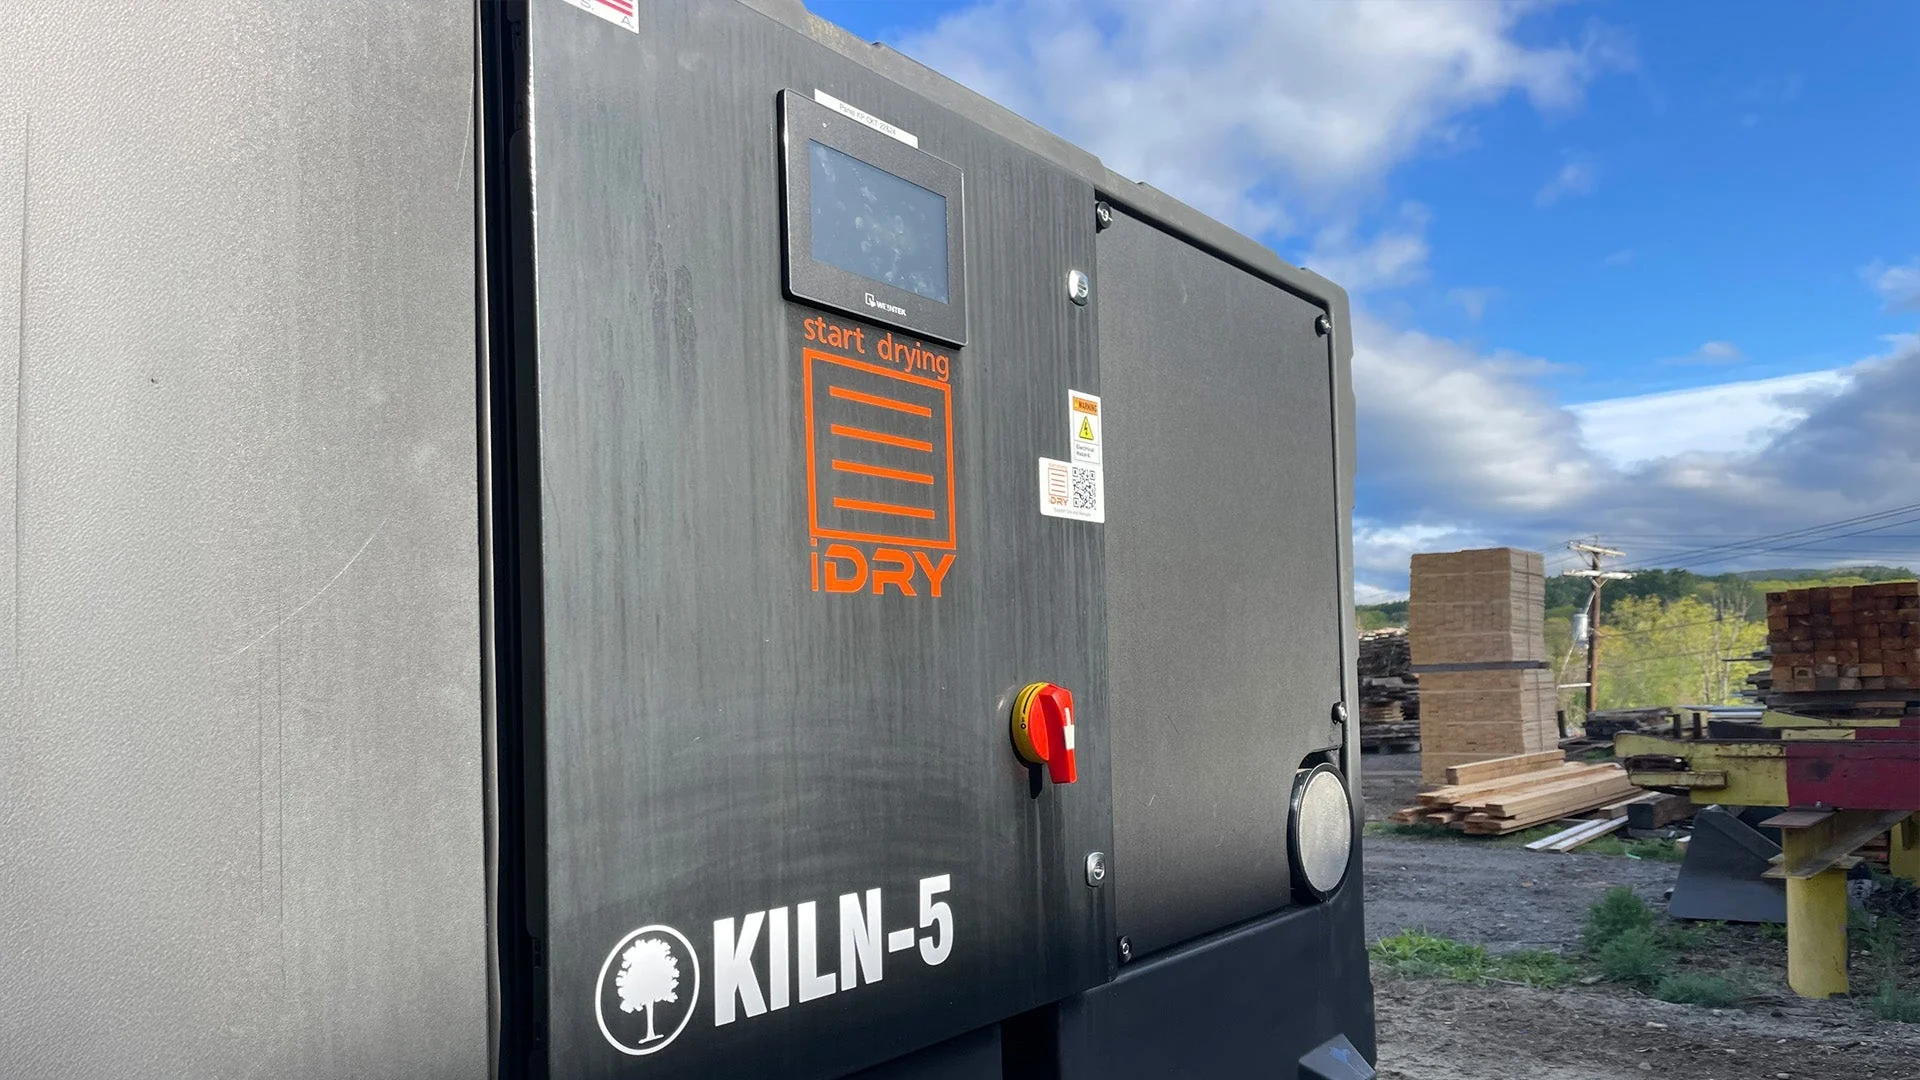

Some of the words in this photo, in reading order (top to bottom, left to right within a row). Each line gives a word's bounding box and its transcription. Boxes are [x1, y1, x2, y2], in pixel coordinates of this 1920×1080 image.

[876, 300, 907, 317] WEINTEK
[803, 317, 864, 354] start
[877, 334, 950, 382] drying
[1078, 401, 1098, 413] WARNING
[810, 536, 957, 598] iDRY
[713, 873, 954, 1027] KILN-5
